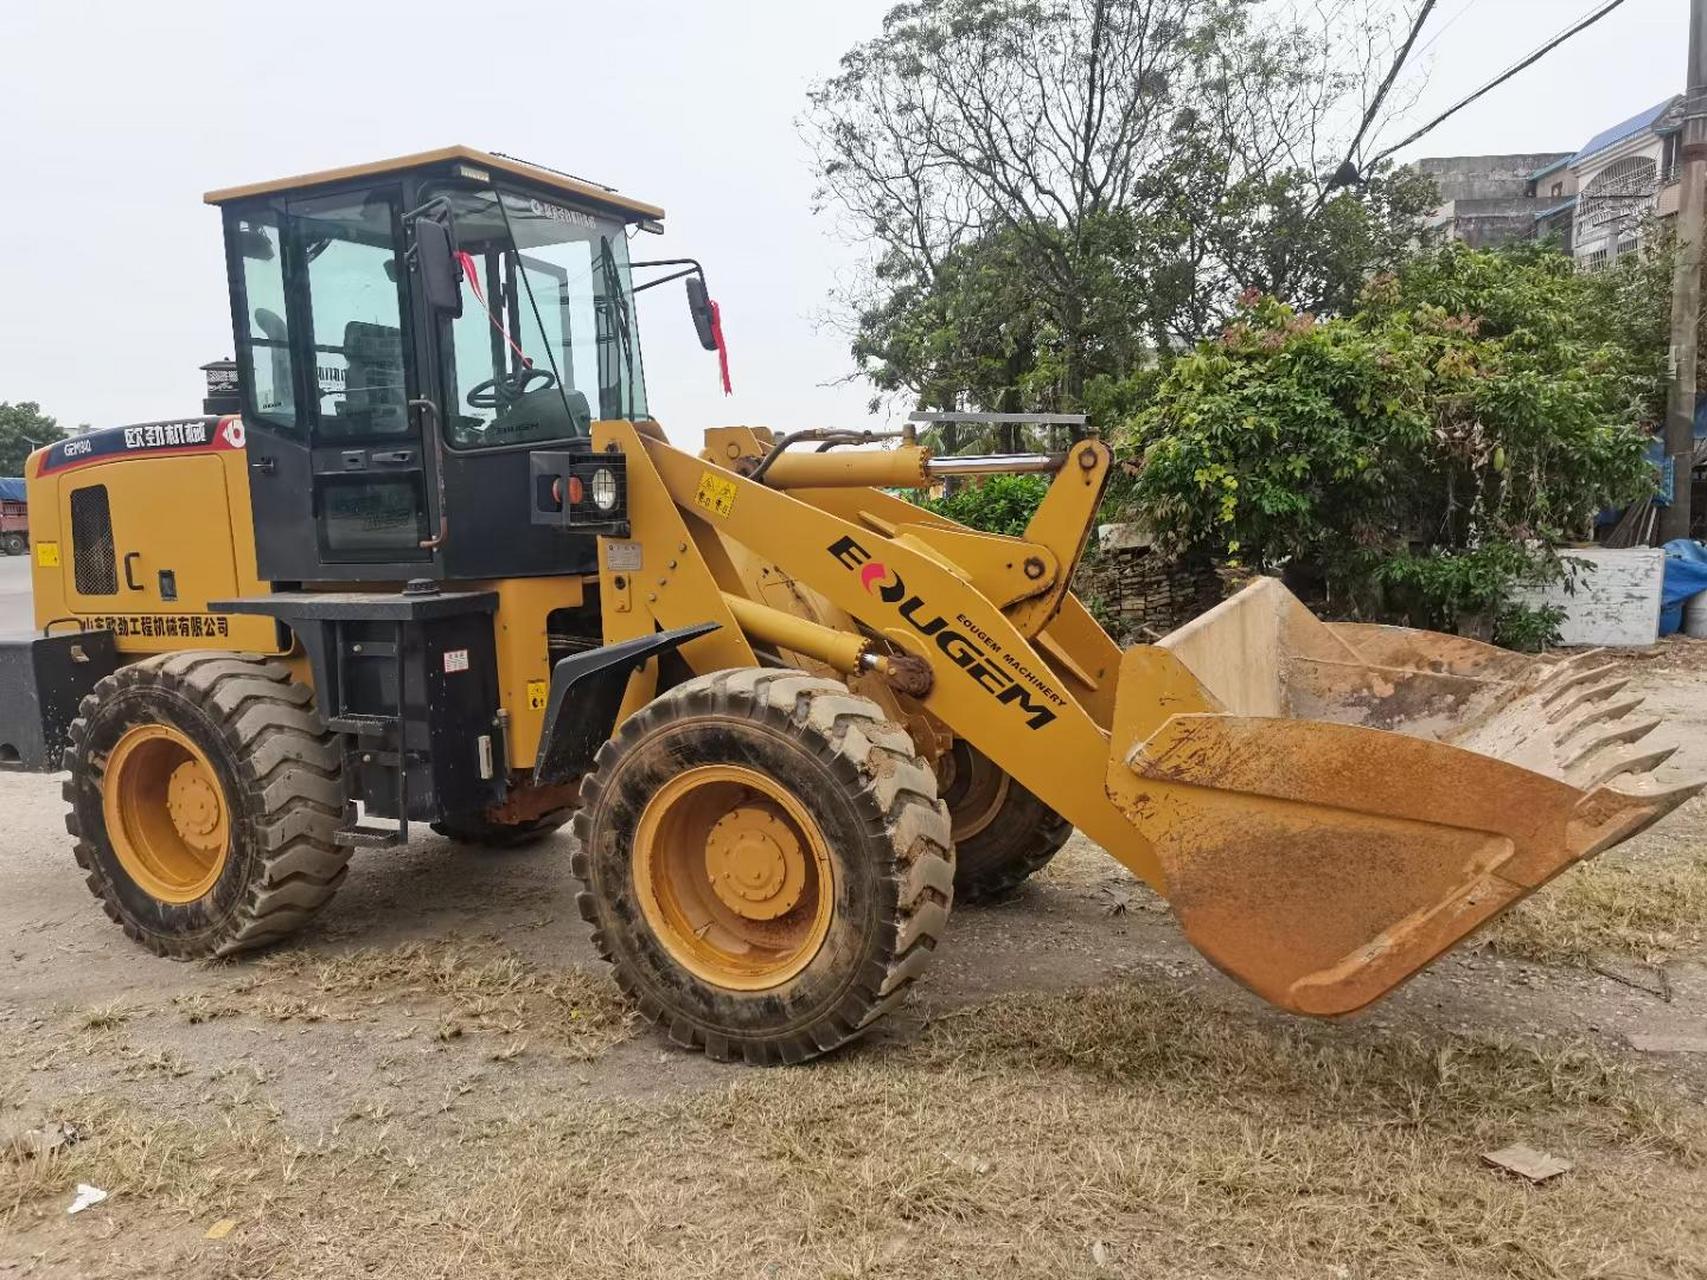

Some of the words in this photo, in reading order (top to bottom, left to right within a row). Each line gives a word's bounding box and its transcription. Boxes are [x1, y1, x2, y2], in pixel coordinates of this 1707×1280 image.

[124, 422, 207, 448] 欧劲机械
[956, 613, 1001, 654] EOUGEM
[1002, 653, 1067, 707] MACHINERY
